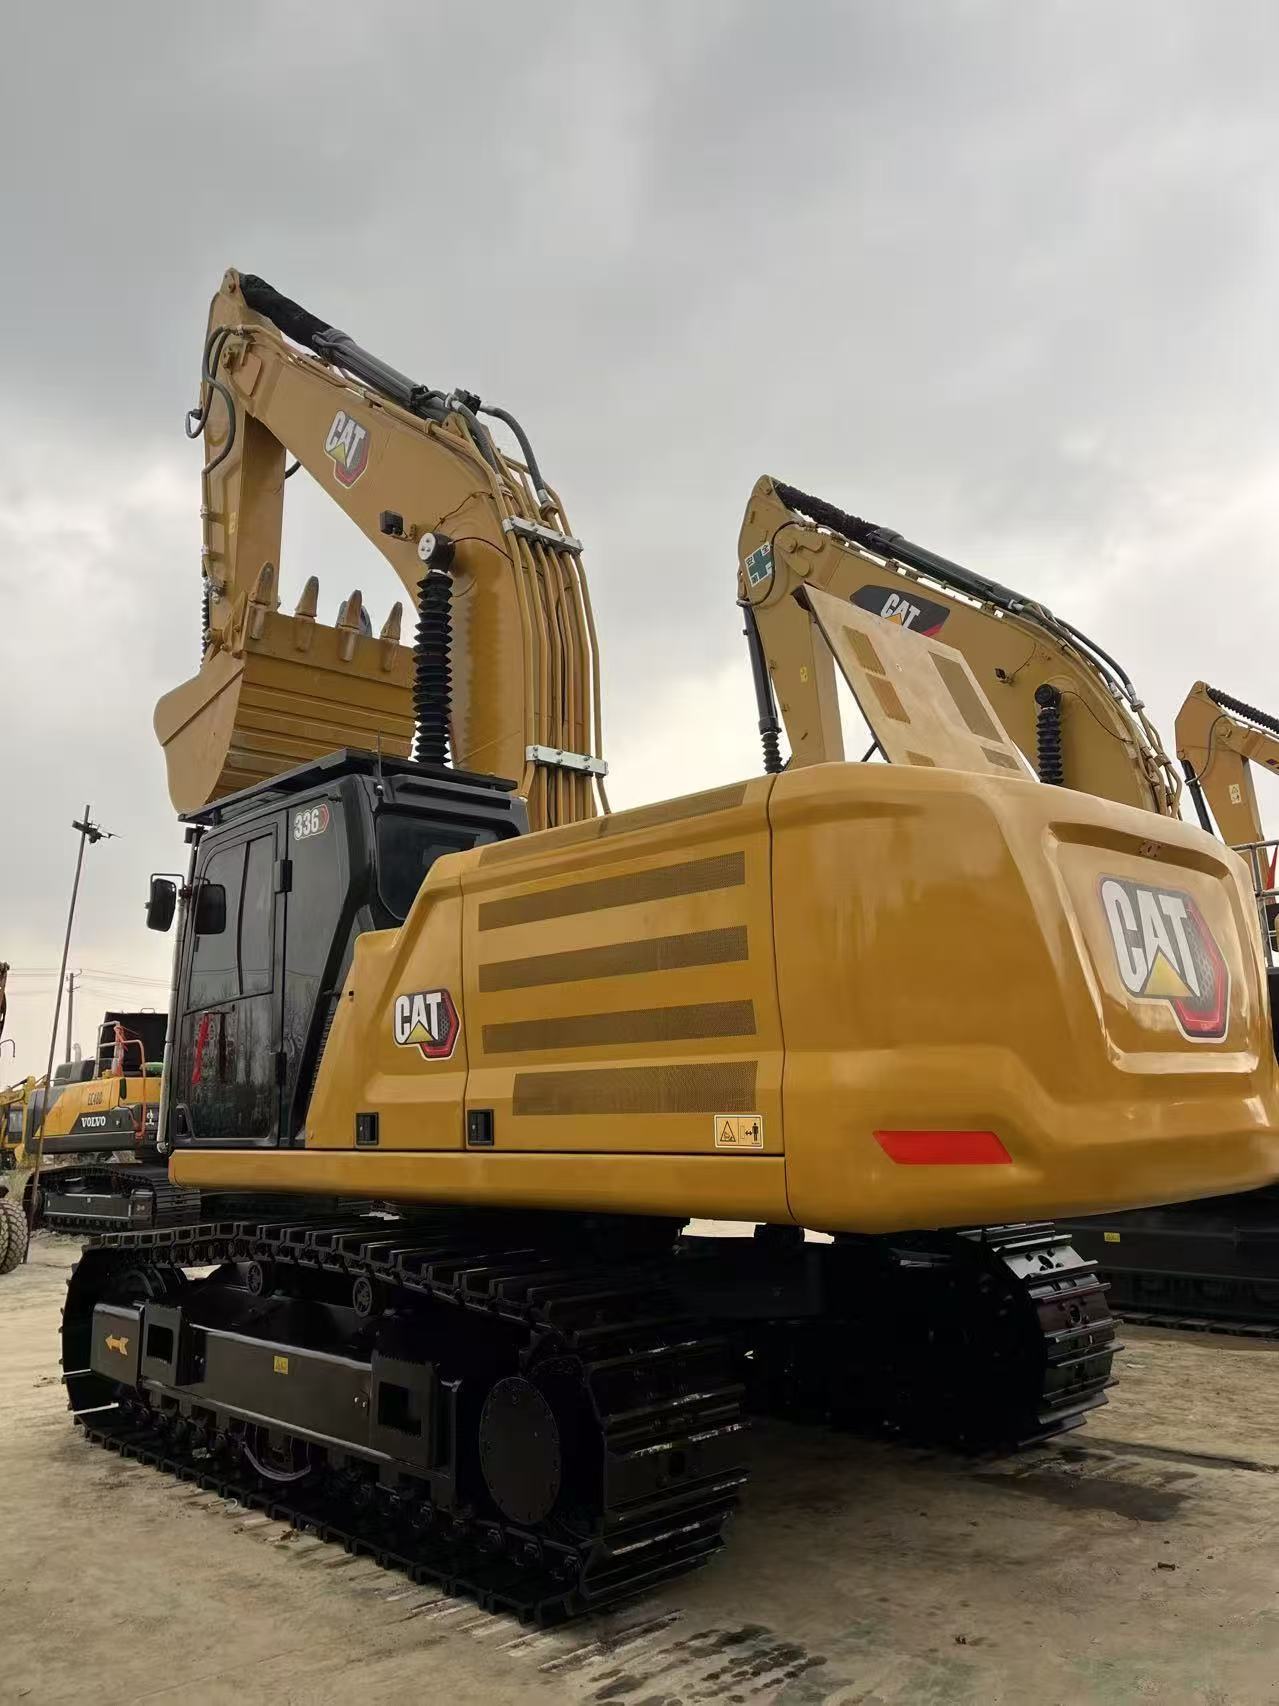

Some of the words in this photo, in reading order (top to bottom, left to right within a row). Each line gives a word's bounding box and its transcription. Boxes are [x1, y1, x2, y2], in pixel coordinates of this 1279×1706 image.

[326, 410, 367, 469] CAT
[880, 593, 921, 629] CAT
[294, 809, 319, 839] 336
[1101, 880, 1201, 998] CAT
[395, 991, 442, 1044] CAT
[81, 1115, 107, 1128] VOLVO
